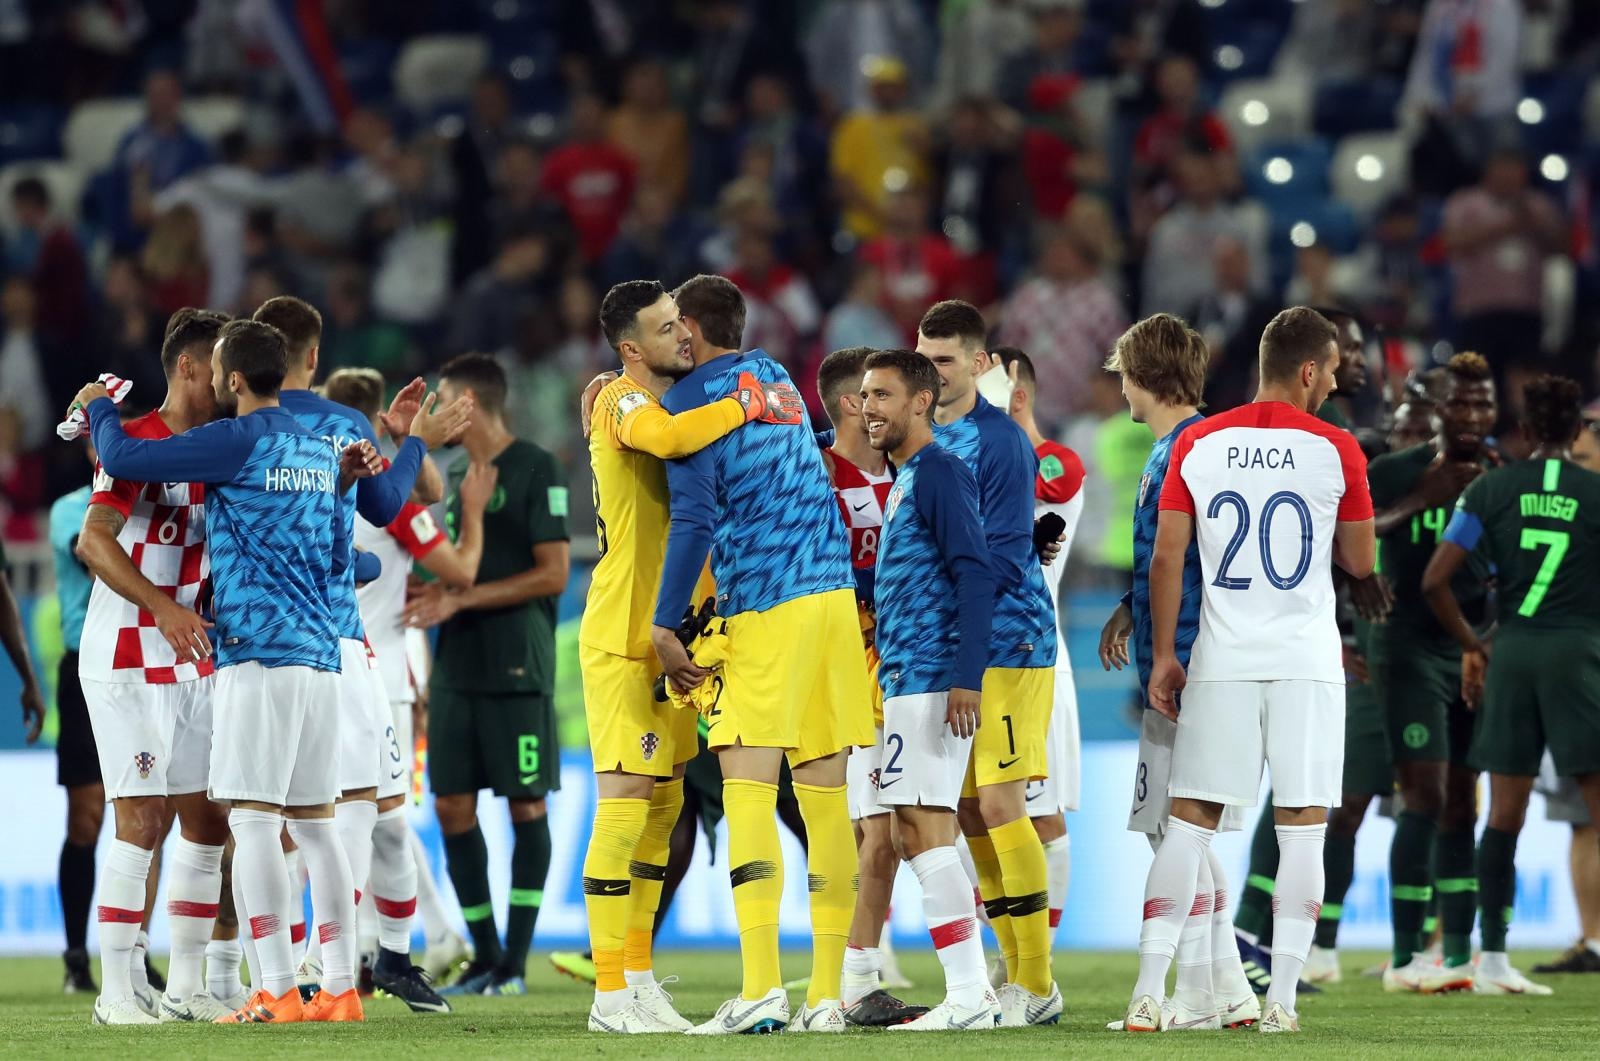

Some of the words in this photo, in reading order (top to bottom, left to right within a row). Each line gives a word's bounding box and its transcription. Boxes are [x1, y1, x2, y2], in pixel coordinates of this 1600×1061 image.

[1227, 446, 1295, 470] PJACA
[158, 507, 180, 546] 6
[1207, 490, 1313, 590] 20
[1411, 506, 1446, 545] 14
[1518, 527, 1570, 618] 7
[386, 726, 400, 763] 3
[518, 734, 540, 774] 6
[884, 732, 904, 774] 2
[1001, 714, 1016, 756] 1
